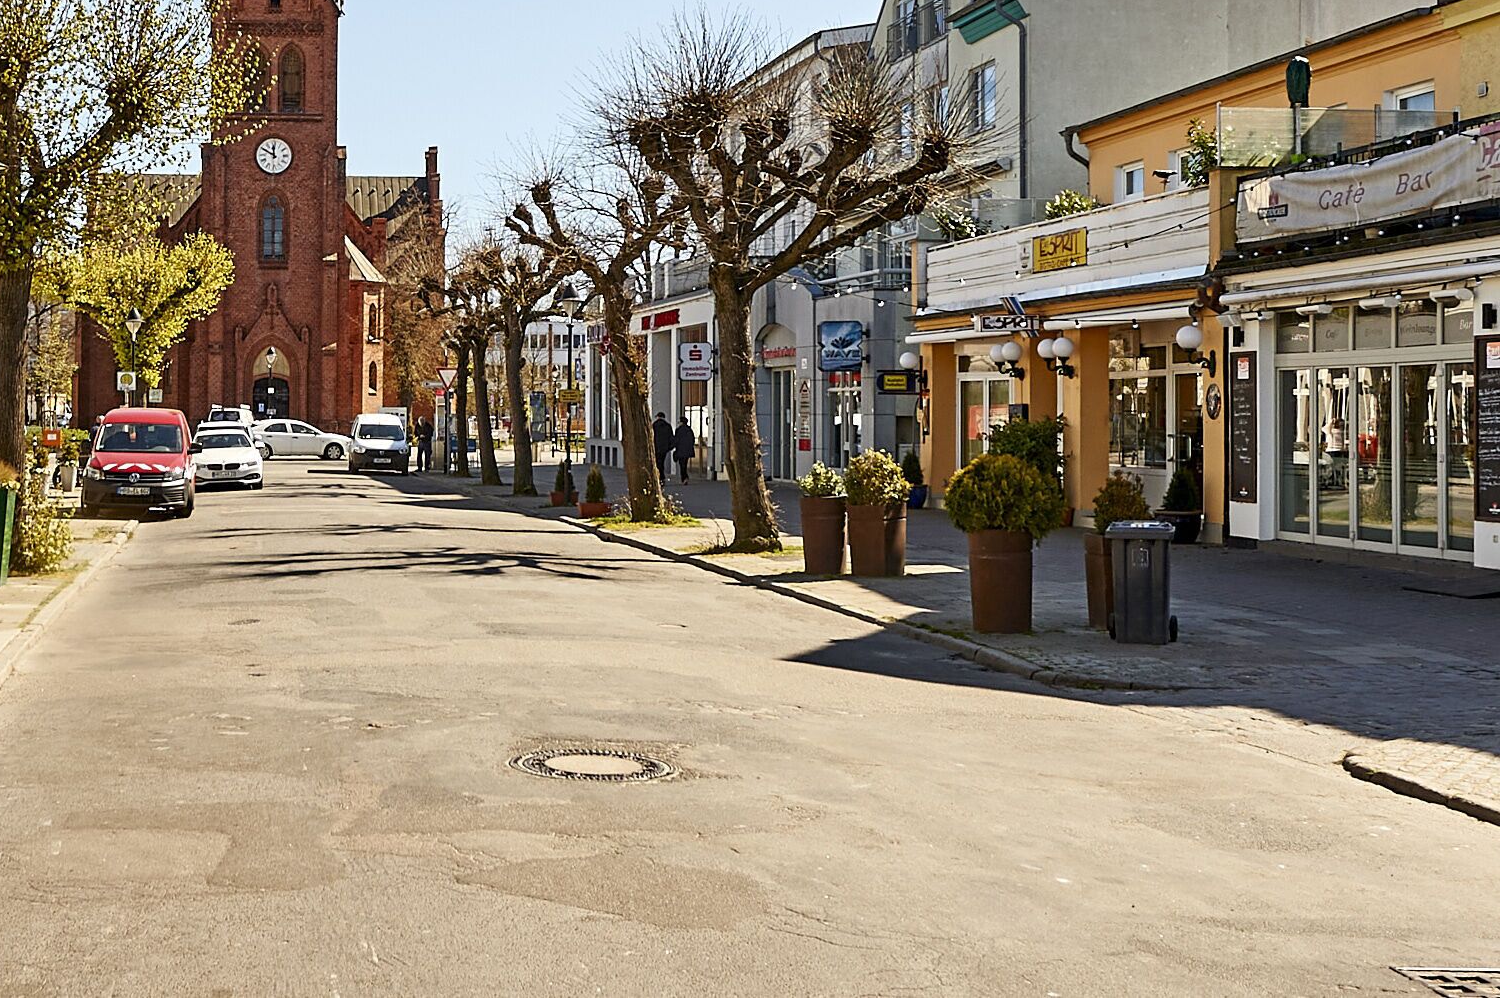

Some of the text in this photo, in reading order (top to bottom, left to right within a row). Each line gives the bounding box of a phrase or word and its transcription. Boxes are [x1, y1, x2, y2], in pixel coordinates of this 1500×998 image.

[1318, 170, 1433, 211] Café Bar
[1039, 230, 1081, 258] ESPRIT
[982, 315, 1038, 330] ESPRIT
[824, 349, 861, 359] WAVE
